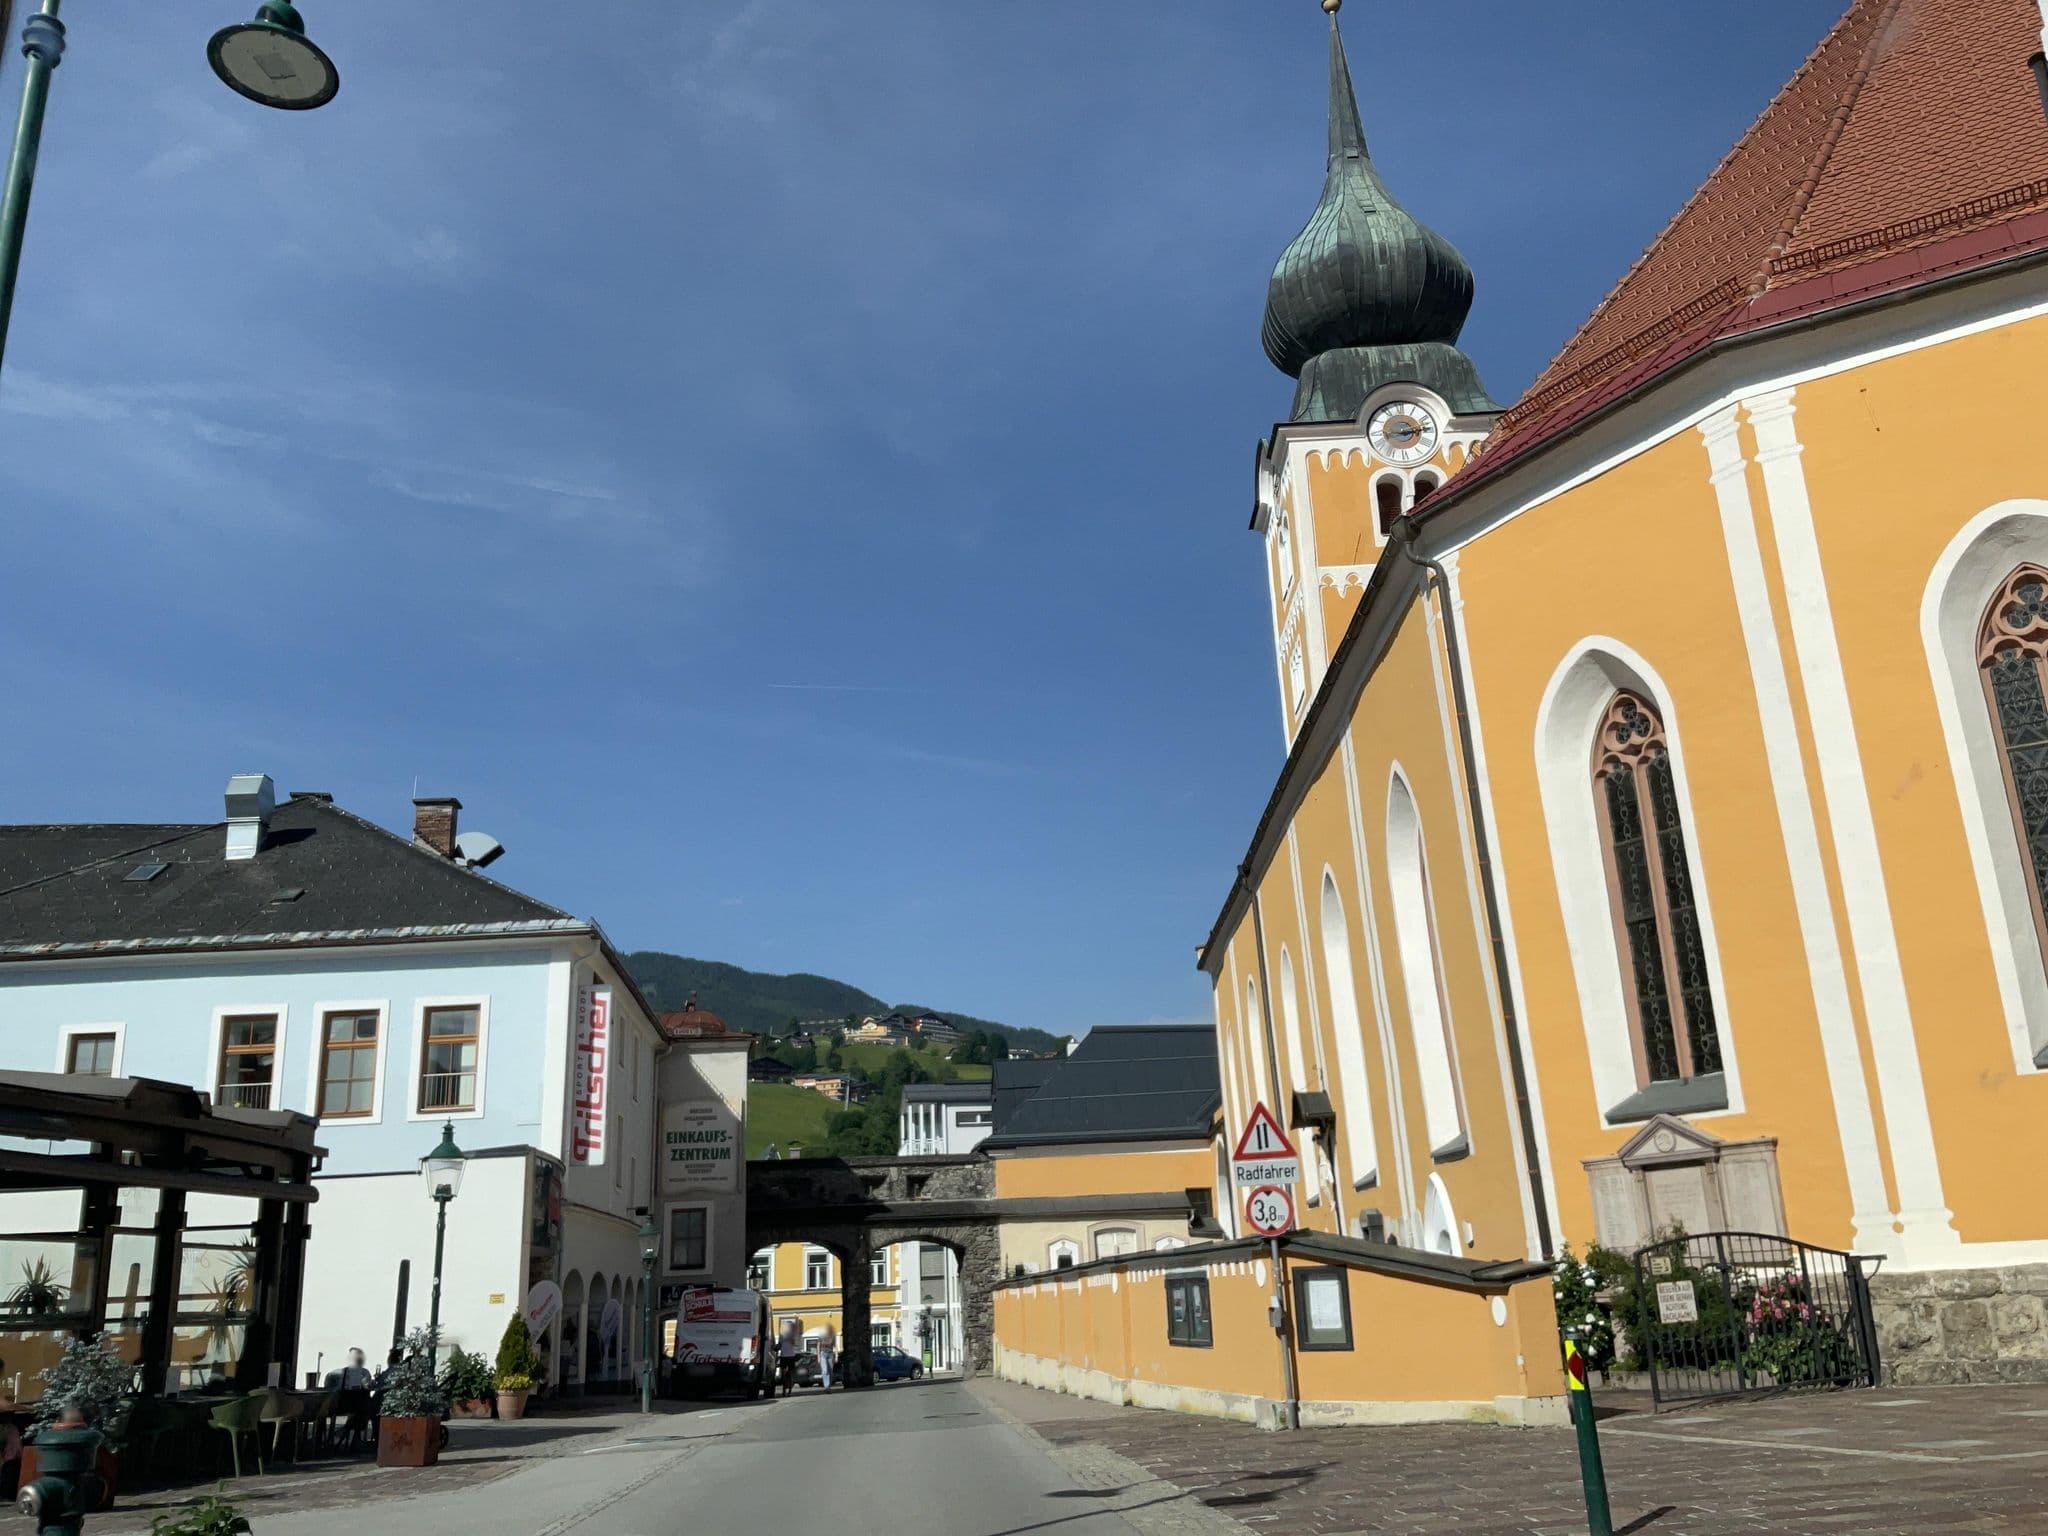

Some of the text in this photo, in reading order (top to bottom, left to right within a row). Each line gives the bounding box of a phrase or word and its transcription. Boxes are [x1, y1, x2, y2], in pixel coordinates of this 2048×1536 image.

[579, 990, 587, 1025] MODE
[573, 991, 608, 1162] Tritscher
[576, 1054, 585, 1095] SPORT
[666, 1129, 733, 1145] EINKAUFS-
[671, 1146, 732, 1161] ZENTRUM
[1236, 1165, 1297, 1181] Radfahrer
